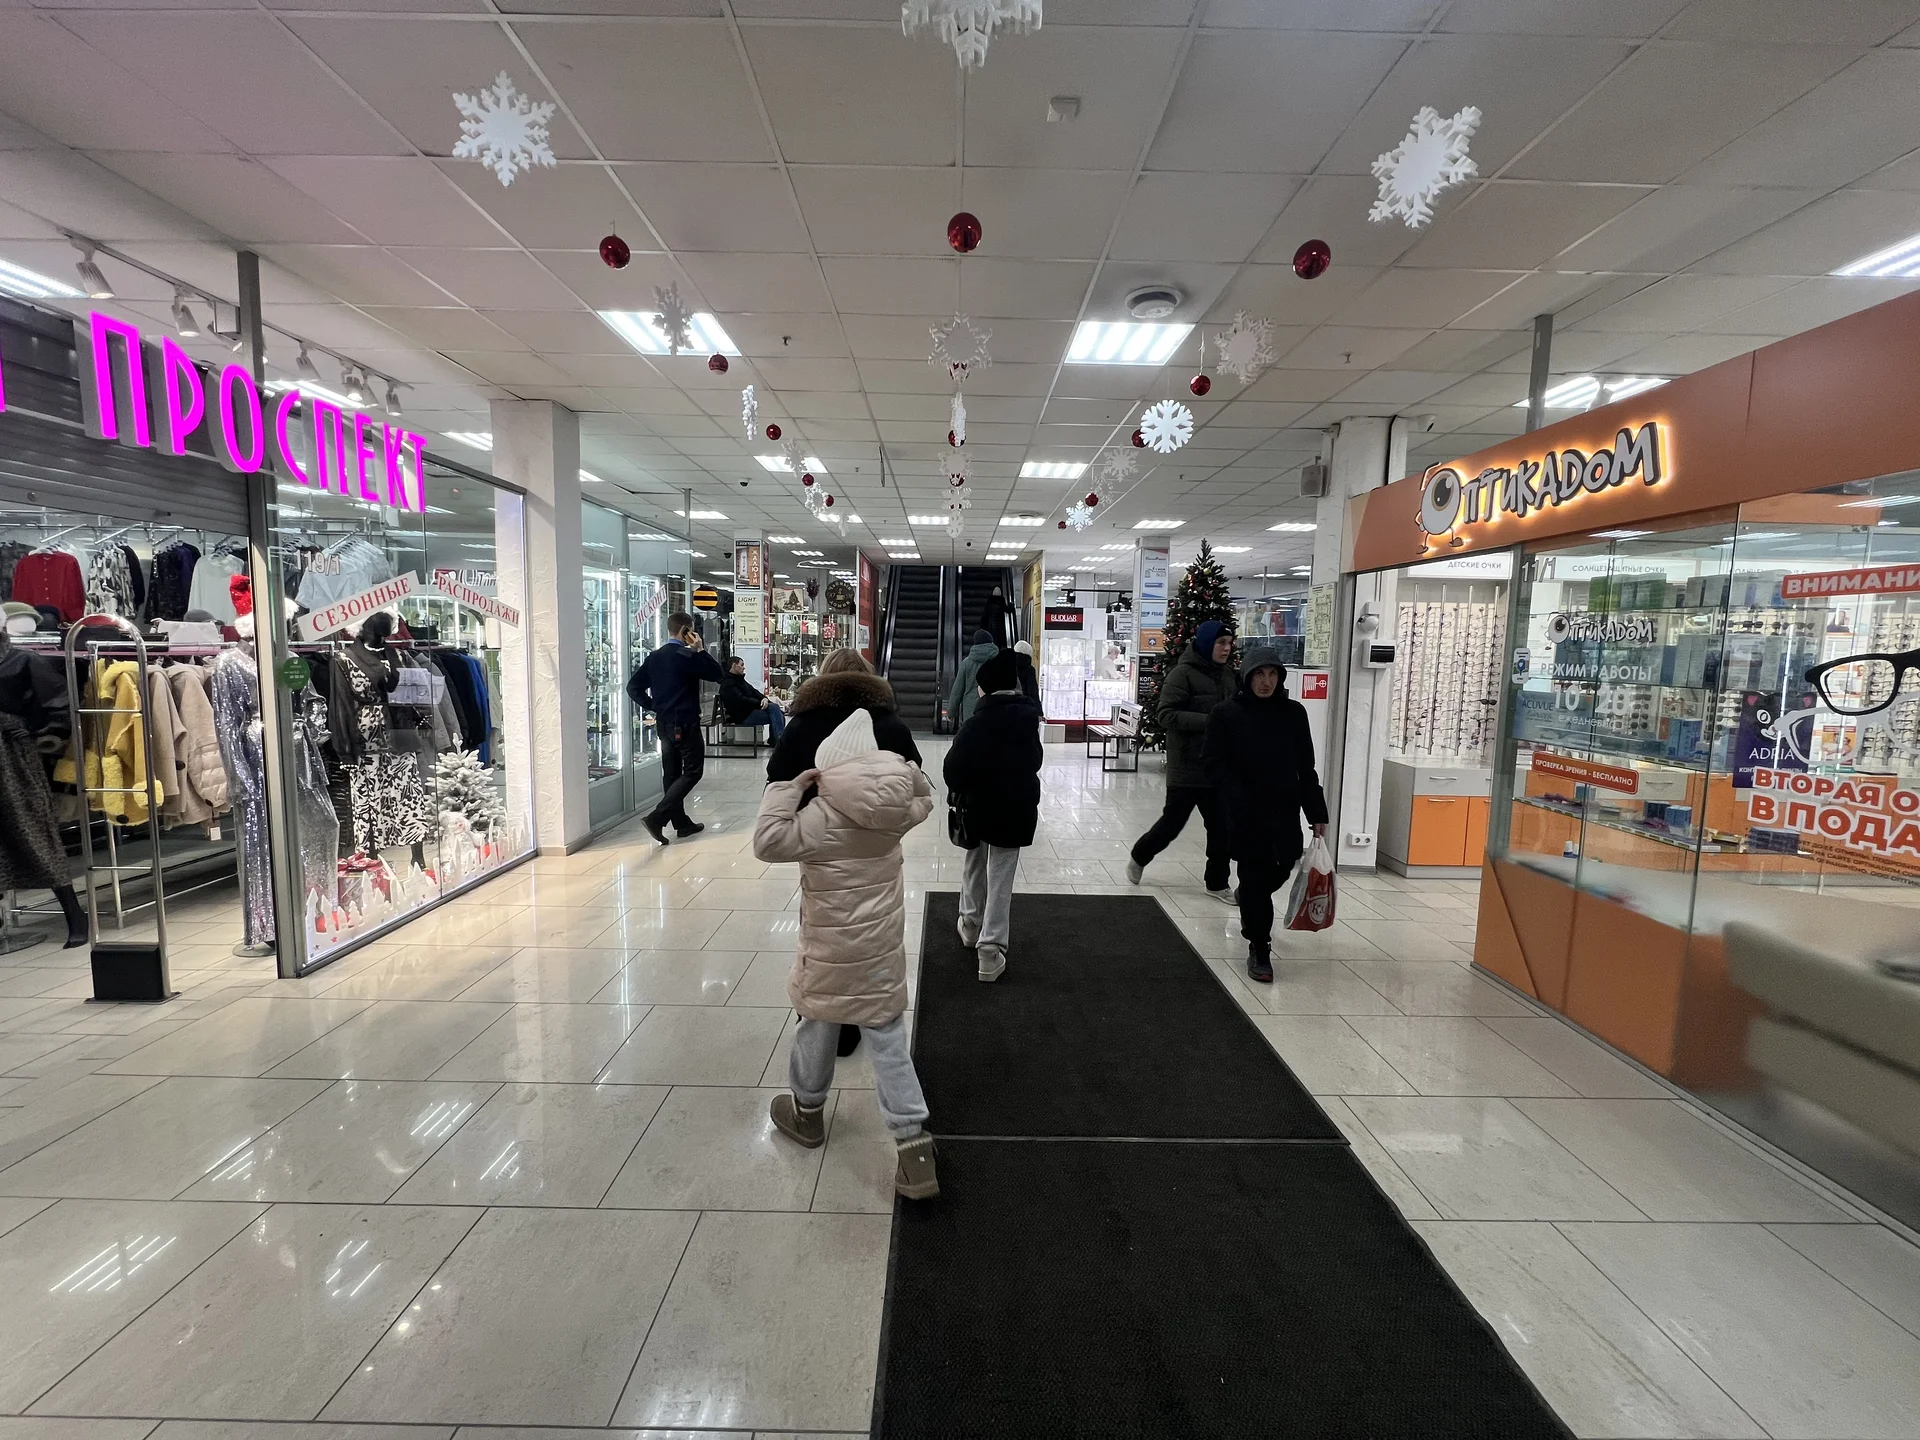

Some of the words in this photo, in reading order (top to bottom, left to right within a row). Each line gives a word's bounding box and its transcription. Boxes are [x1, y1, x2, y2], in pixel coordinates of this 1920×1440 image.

[89, 310, 427, 514] ПРОСПЕКТ
[293, 549, 341, 576] 119/1
[1522, 557, 1556, 583] 11/1
[312, 577, 412, 632] СЕЗОННЫЕ
[438, 576, 520, 625] РАСПРОДАЖИ
[1541, 663, 1587, 678] РЕЖИМ
[1590, 665, 1652, 681] РАБОТЫ
[1535, 759, 1564, 771] ПРОВЕРКА
[1565, 764, 1587, 776] ЗРЕНИЯ
[1592, 771, 1633, 786] БЕСПЛАТНО
[1755, 768, 1881, 807] ВТОРАЯ
[1750, 794, 1776, 822] В
